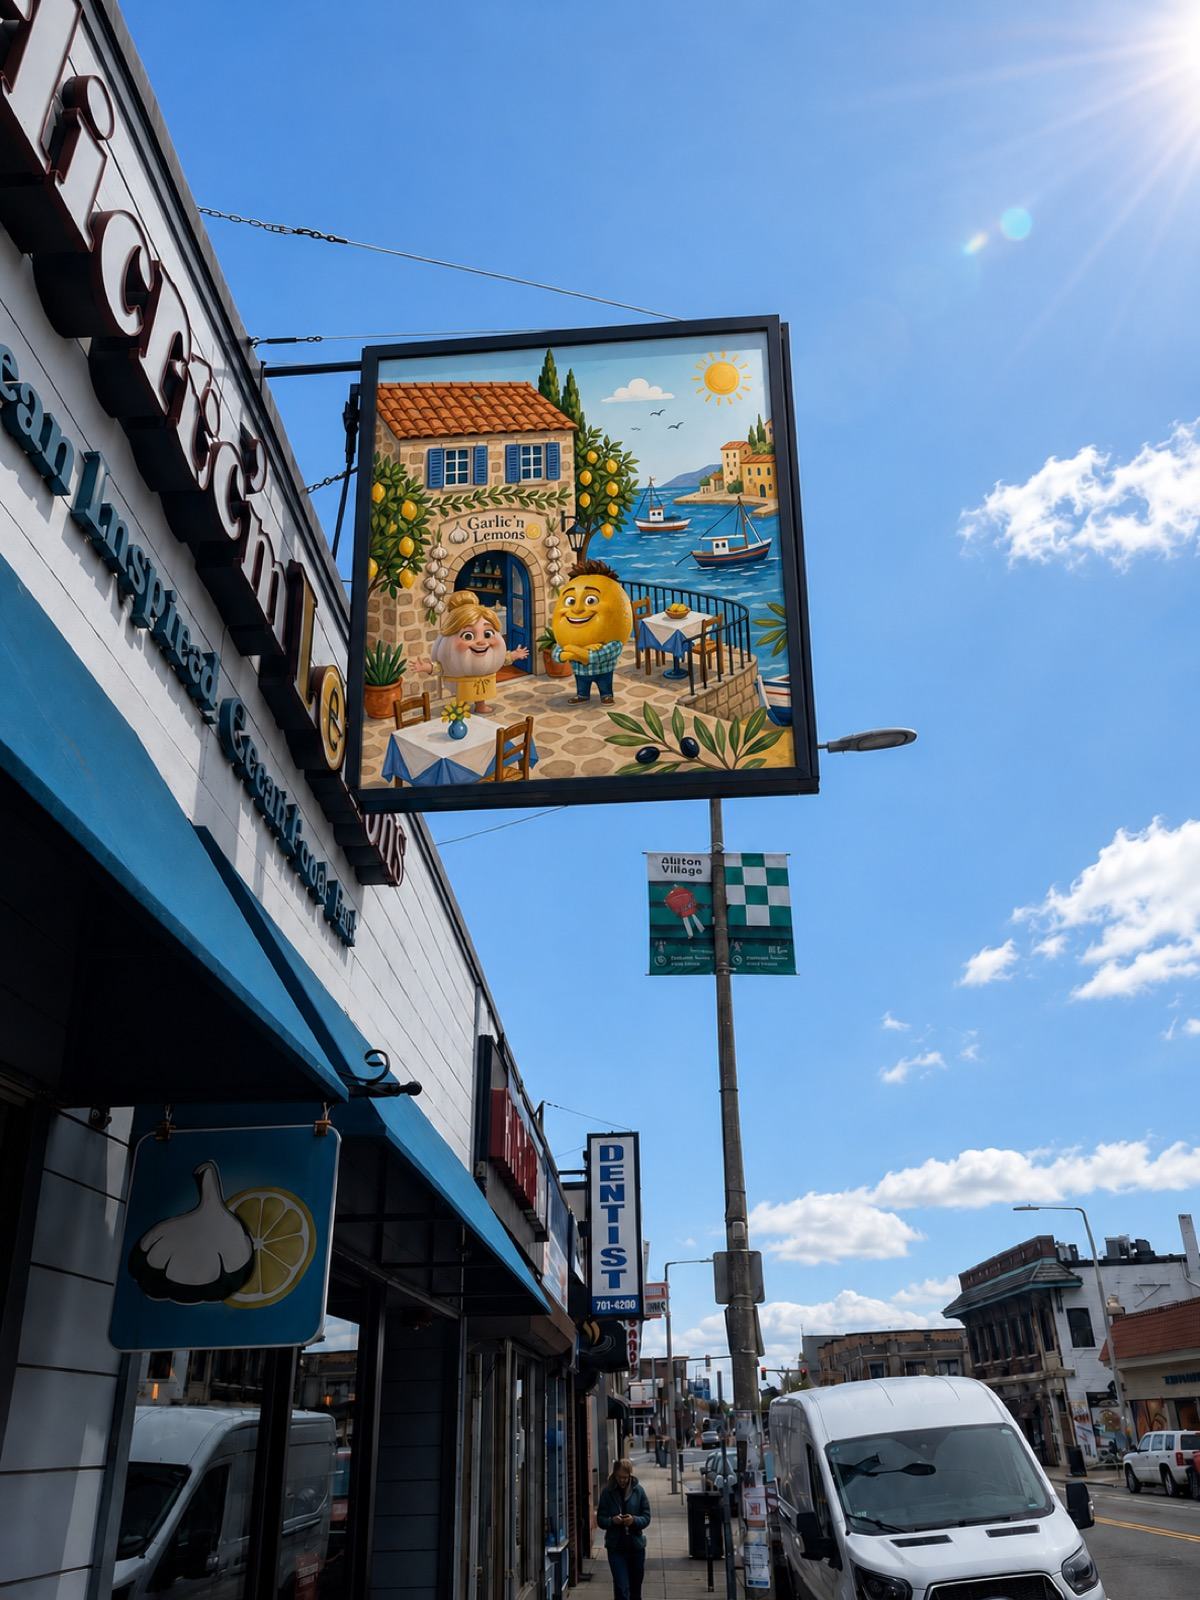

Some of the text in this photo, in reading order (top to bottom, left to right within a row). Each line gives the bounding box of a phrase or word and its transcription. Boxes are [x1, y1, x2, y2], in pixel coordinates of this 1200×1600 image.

[467, 515, 525, 530] Garlic'n
[473, 529, 525, 543] Lemons
[599, 1144, 628, 1289] DENTIST
